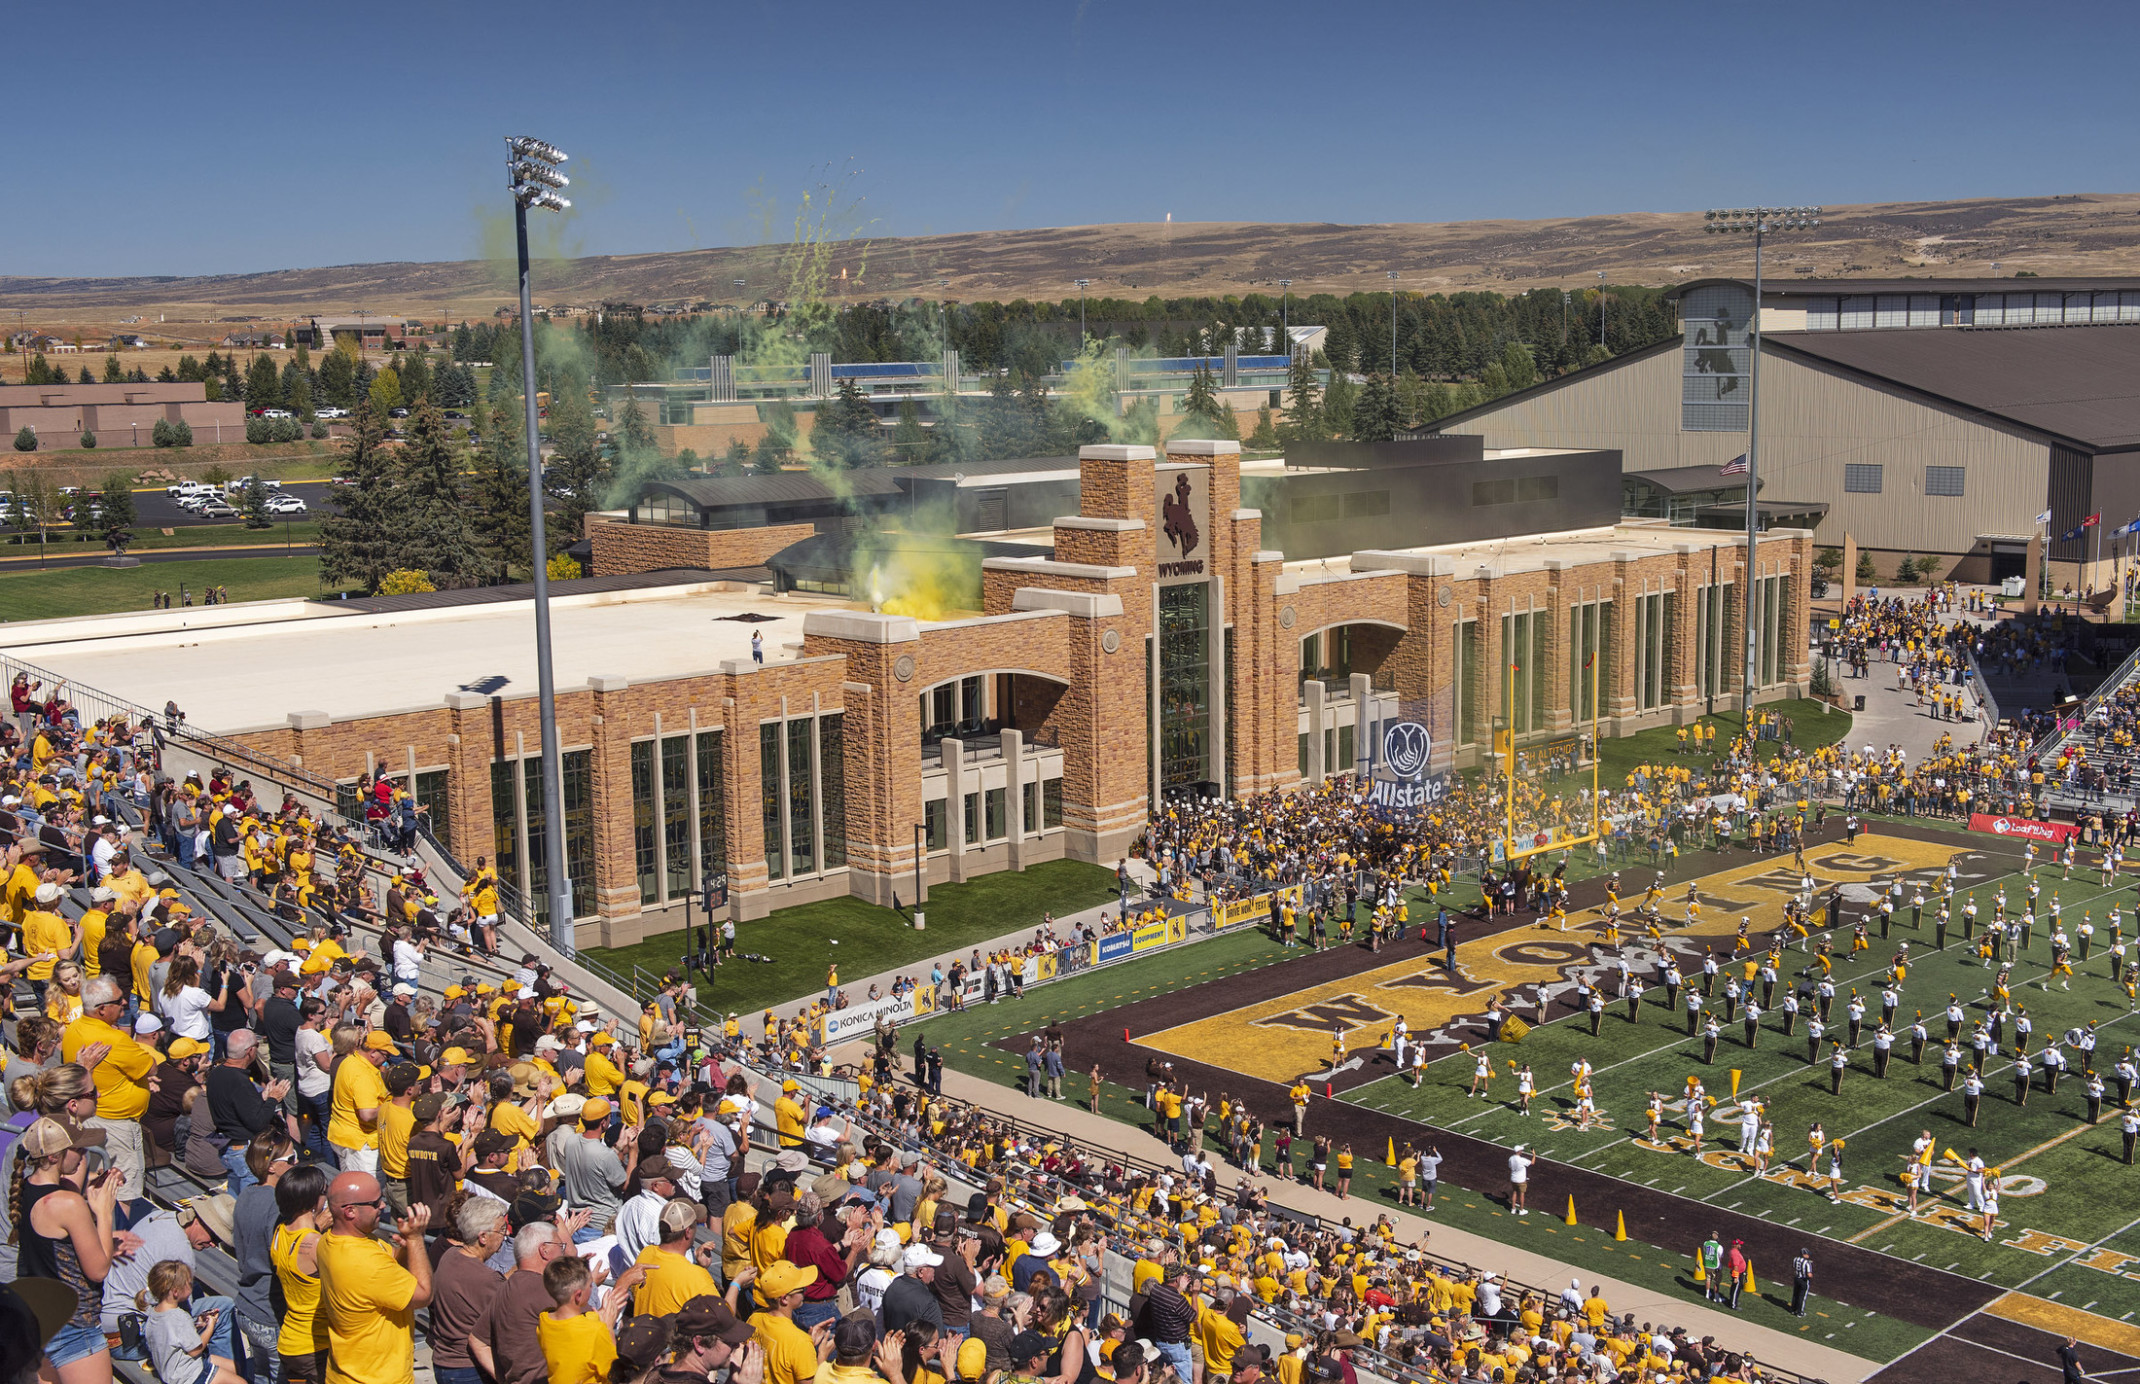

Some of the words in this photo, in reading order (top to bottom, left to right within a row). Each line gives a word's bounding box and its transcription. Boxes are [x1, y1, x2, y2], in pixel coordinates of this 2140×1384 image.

[1158, 559, 1204, 578] WYOMING
[1368, 779, 1442, 808] Allstate
[710, 890, 723, 908] 25
[1226, 907, 1240, 919] DRIVE
[1255, 900, 1267, 911] TEXT
[1102, 939, 1131, 954] KOMATSU
[1134, 930, 1164, 945] EQUIPMENT
[840, 1011, 875, 1029] KONICA
[876, 1001, 913, 1016] MINOLTA
[686, 1034, 699, 1047] 21
